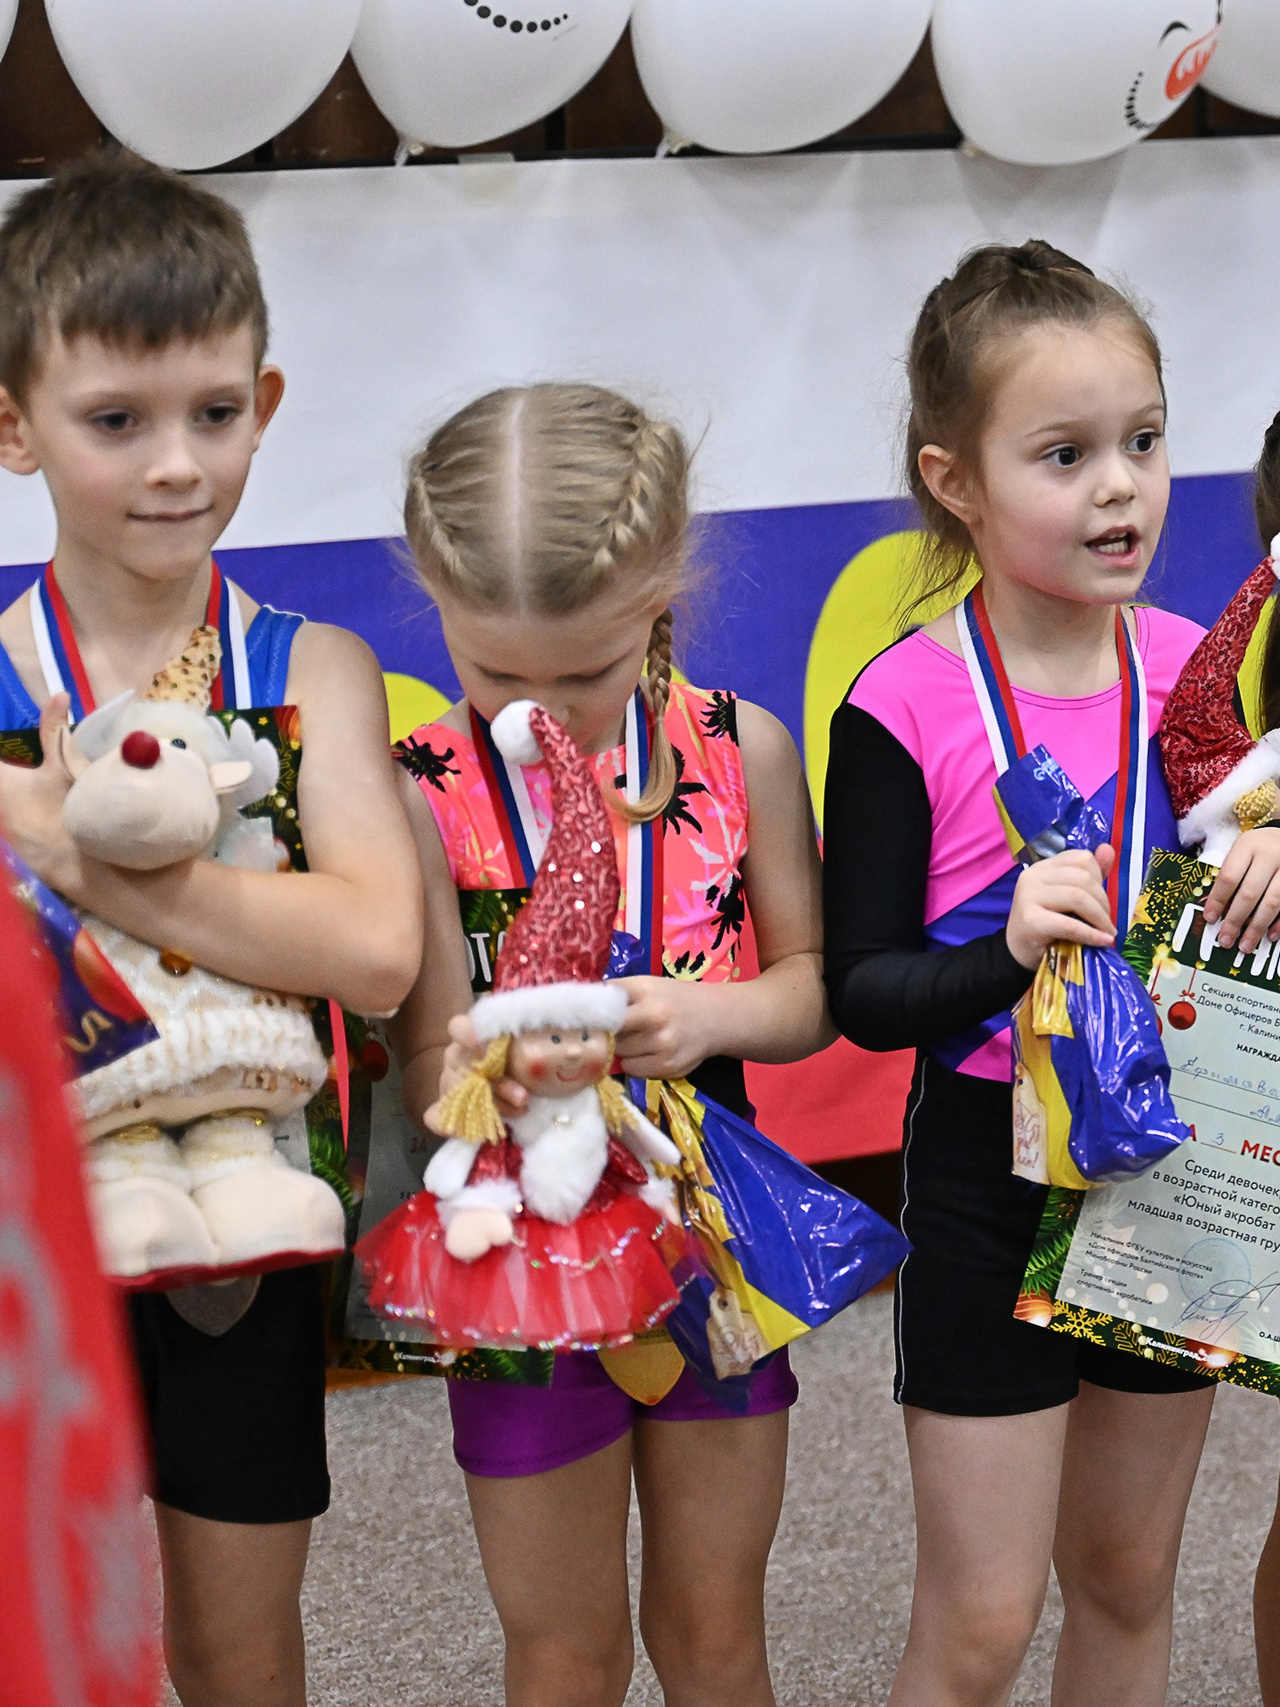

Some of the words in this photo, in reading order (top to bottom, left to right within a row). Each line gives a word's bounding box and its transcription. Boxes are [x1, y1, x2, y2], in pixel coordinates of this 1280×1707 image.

[1201, 983, 1235, 999] Секция
[1196, 995, 1223, 1010] Доме
[1224, 1003, 1272, 1025] Офицеров
[1239, 1023, 1246, 1031] г.
[1184, 1159, 1225, 1181] Среди
[1152, 1170, 1160, 1179] в
[1163, 1174, 1238, 1202] возрастной
[1127, 1200, 1183, 1223] младшая
[1185, 1216, 1258, 1244] возрастная
[1173, 1193, 1222, 1216] «Юный
[1224, 1210, 1277, 1232] акробат
[1085, 1250, 1128, 1268] Минобороны
[1128, 1262, 1153, 1275] России
[1107, 1247, 1139, 1260] офицеров
[1139, 1255, 1180, 1273] Балтийского
[1180, 1267, 1204, 1280] флота»
[1125, 1241, 1145, 1252] ФГБУ
[1145, 1249, 1175, 1262] культуры
[1180, 1258, 1213, 1272] искусства
[1080, 1268, 1104, 1281] Тренер
